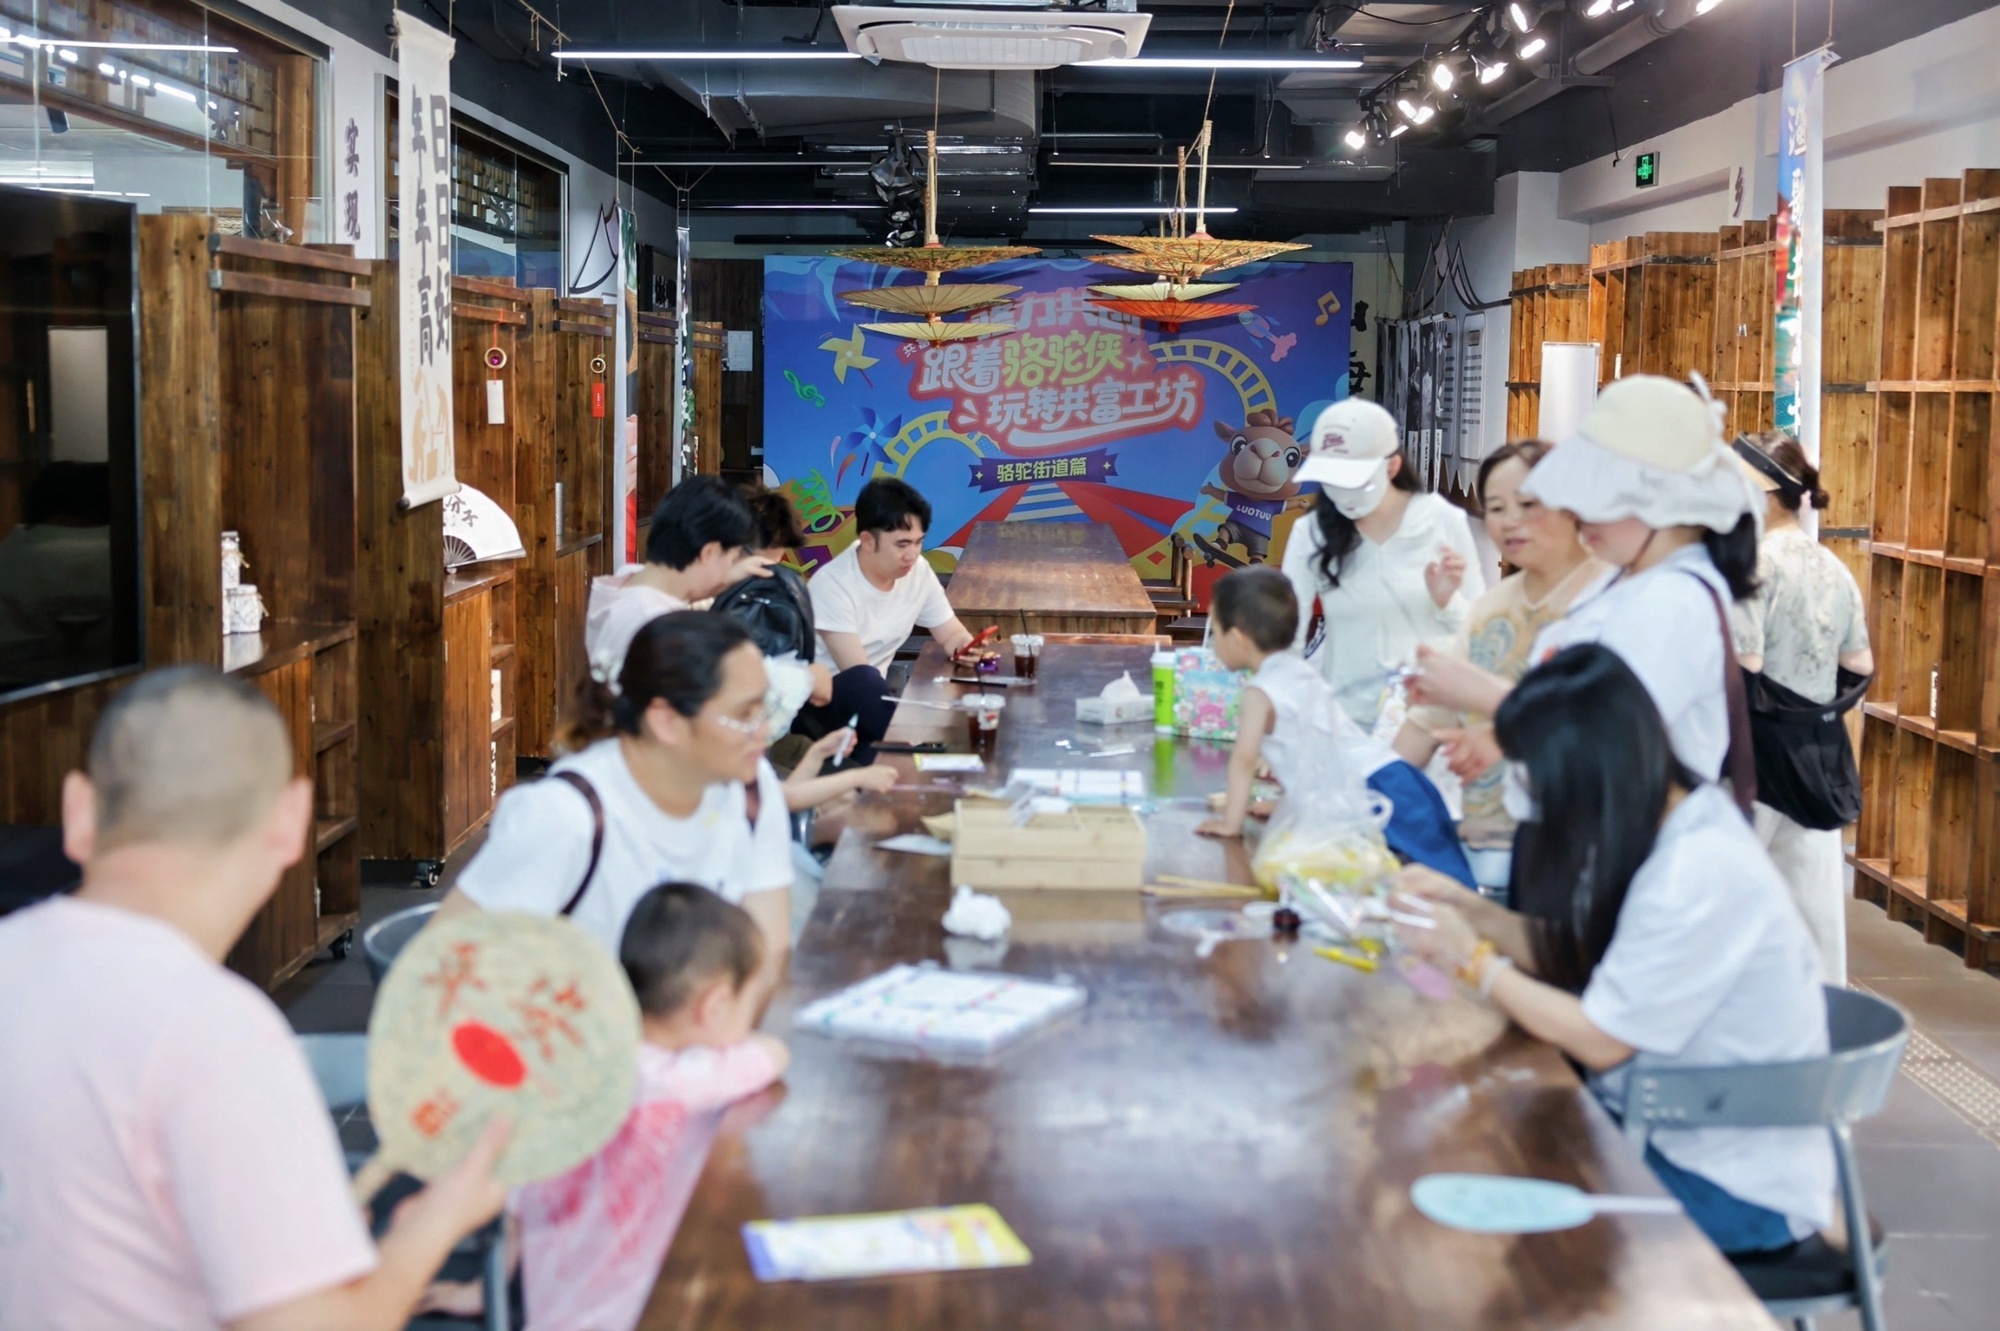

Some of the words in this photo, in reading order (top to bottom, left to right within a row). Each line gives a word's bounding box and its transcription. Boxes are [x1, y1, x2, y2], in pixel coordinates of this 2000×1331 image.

[411, 83, 433, 367] 年年高
[918, 329, 1125, 394] 跟着骆驼侠
[986, 373, 1197, 433] 玩转共富工坊
[996, 456, 1087, 483] 骆驼街道篇
